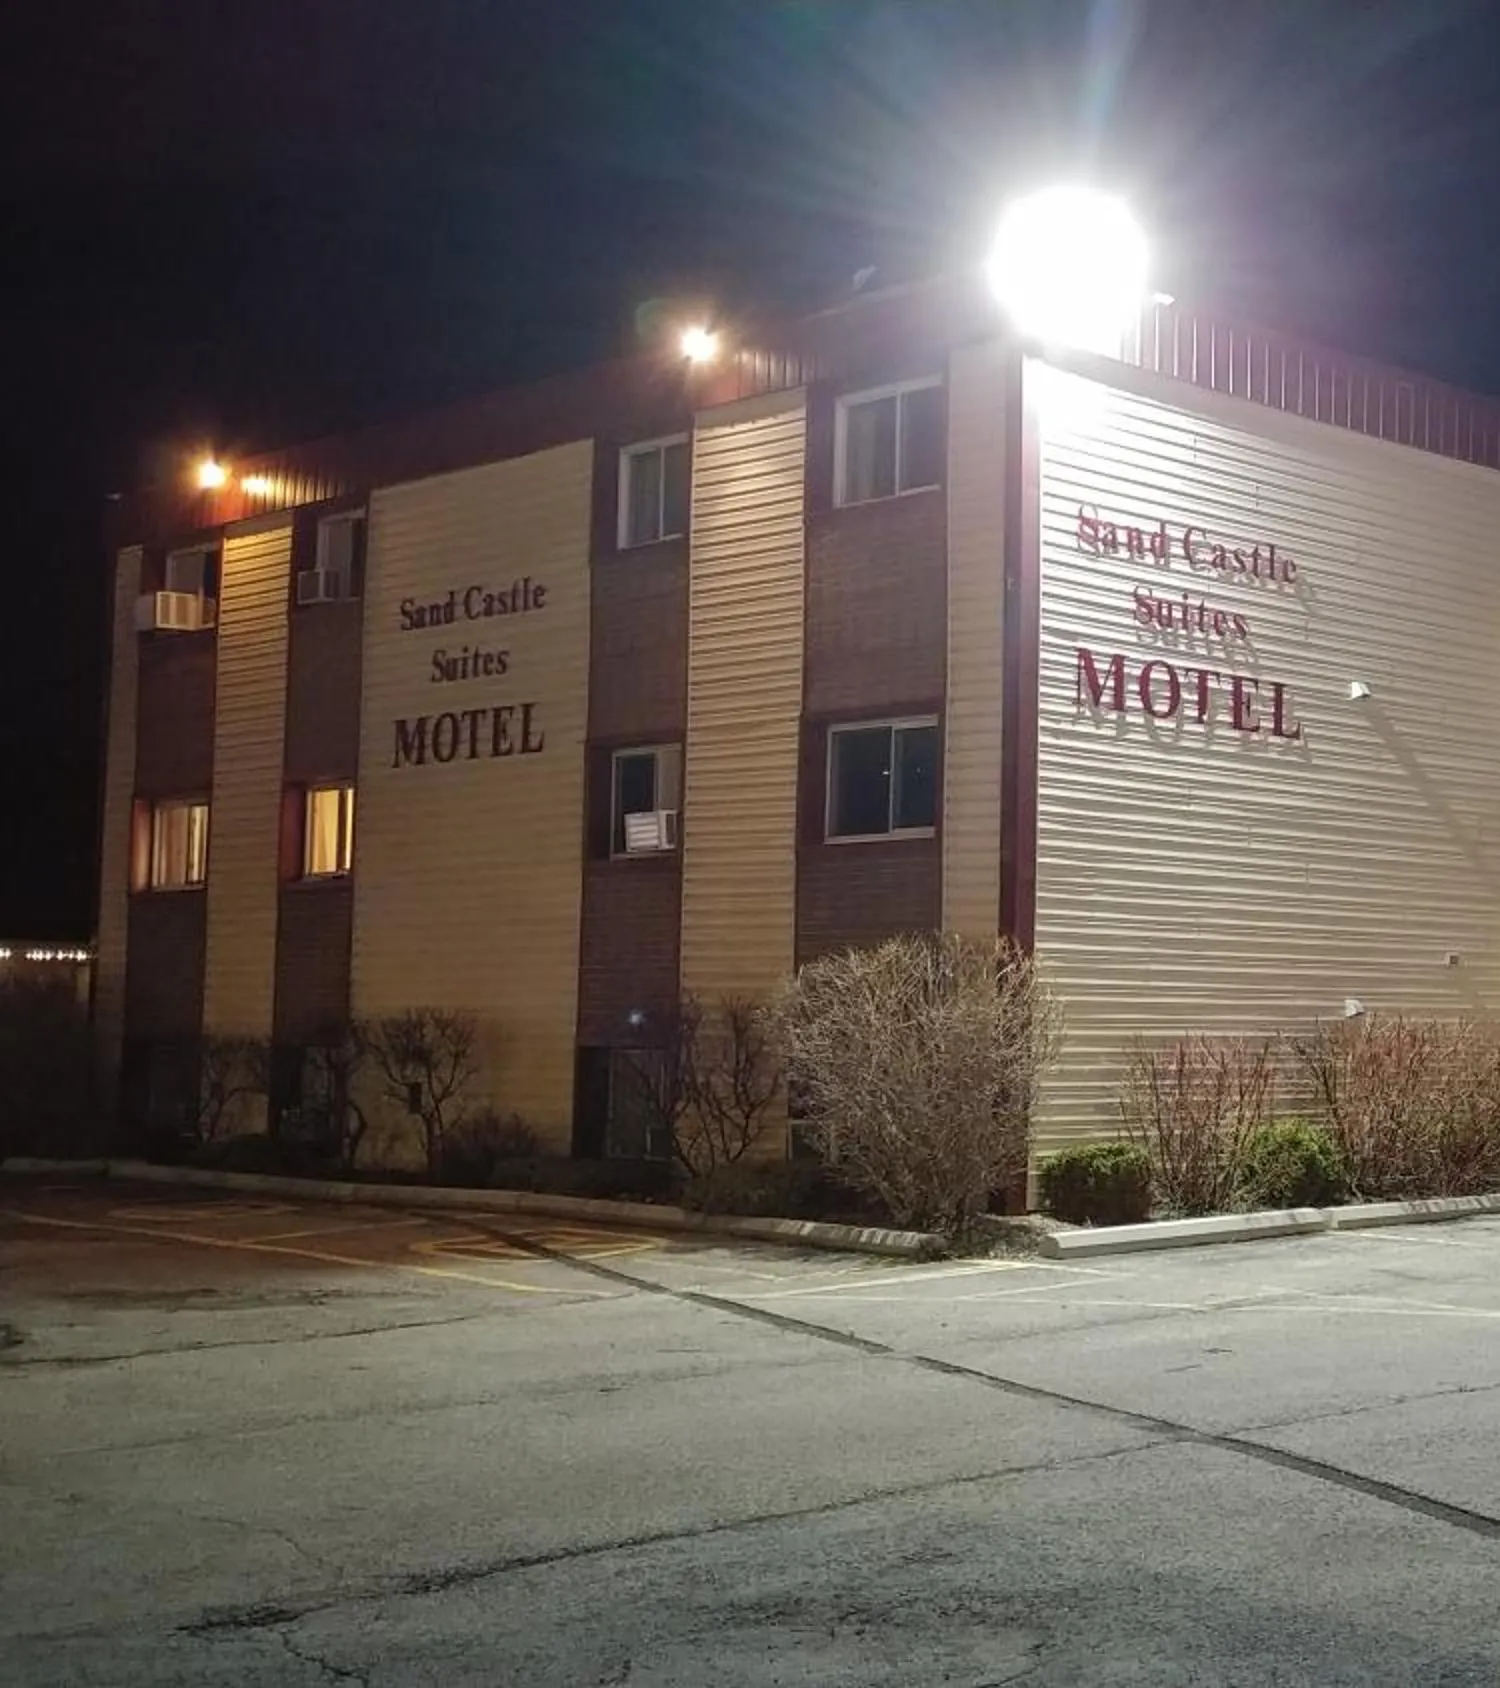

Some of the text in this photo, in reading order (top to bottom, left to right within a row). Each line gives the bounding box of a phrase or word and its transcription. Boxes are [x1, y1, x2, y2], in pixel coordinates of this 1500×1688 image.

[1076, 502, 1297, 583] Sand Castle
[400, 576, 547, 631] Sand Castle
[1132, 585, 1248, 640] Suites
[431, 645, 510, 682] Suites
[1073, 647, 1301, 739] MOTEL
[392, 703, 545, 768] MOTEL
